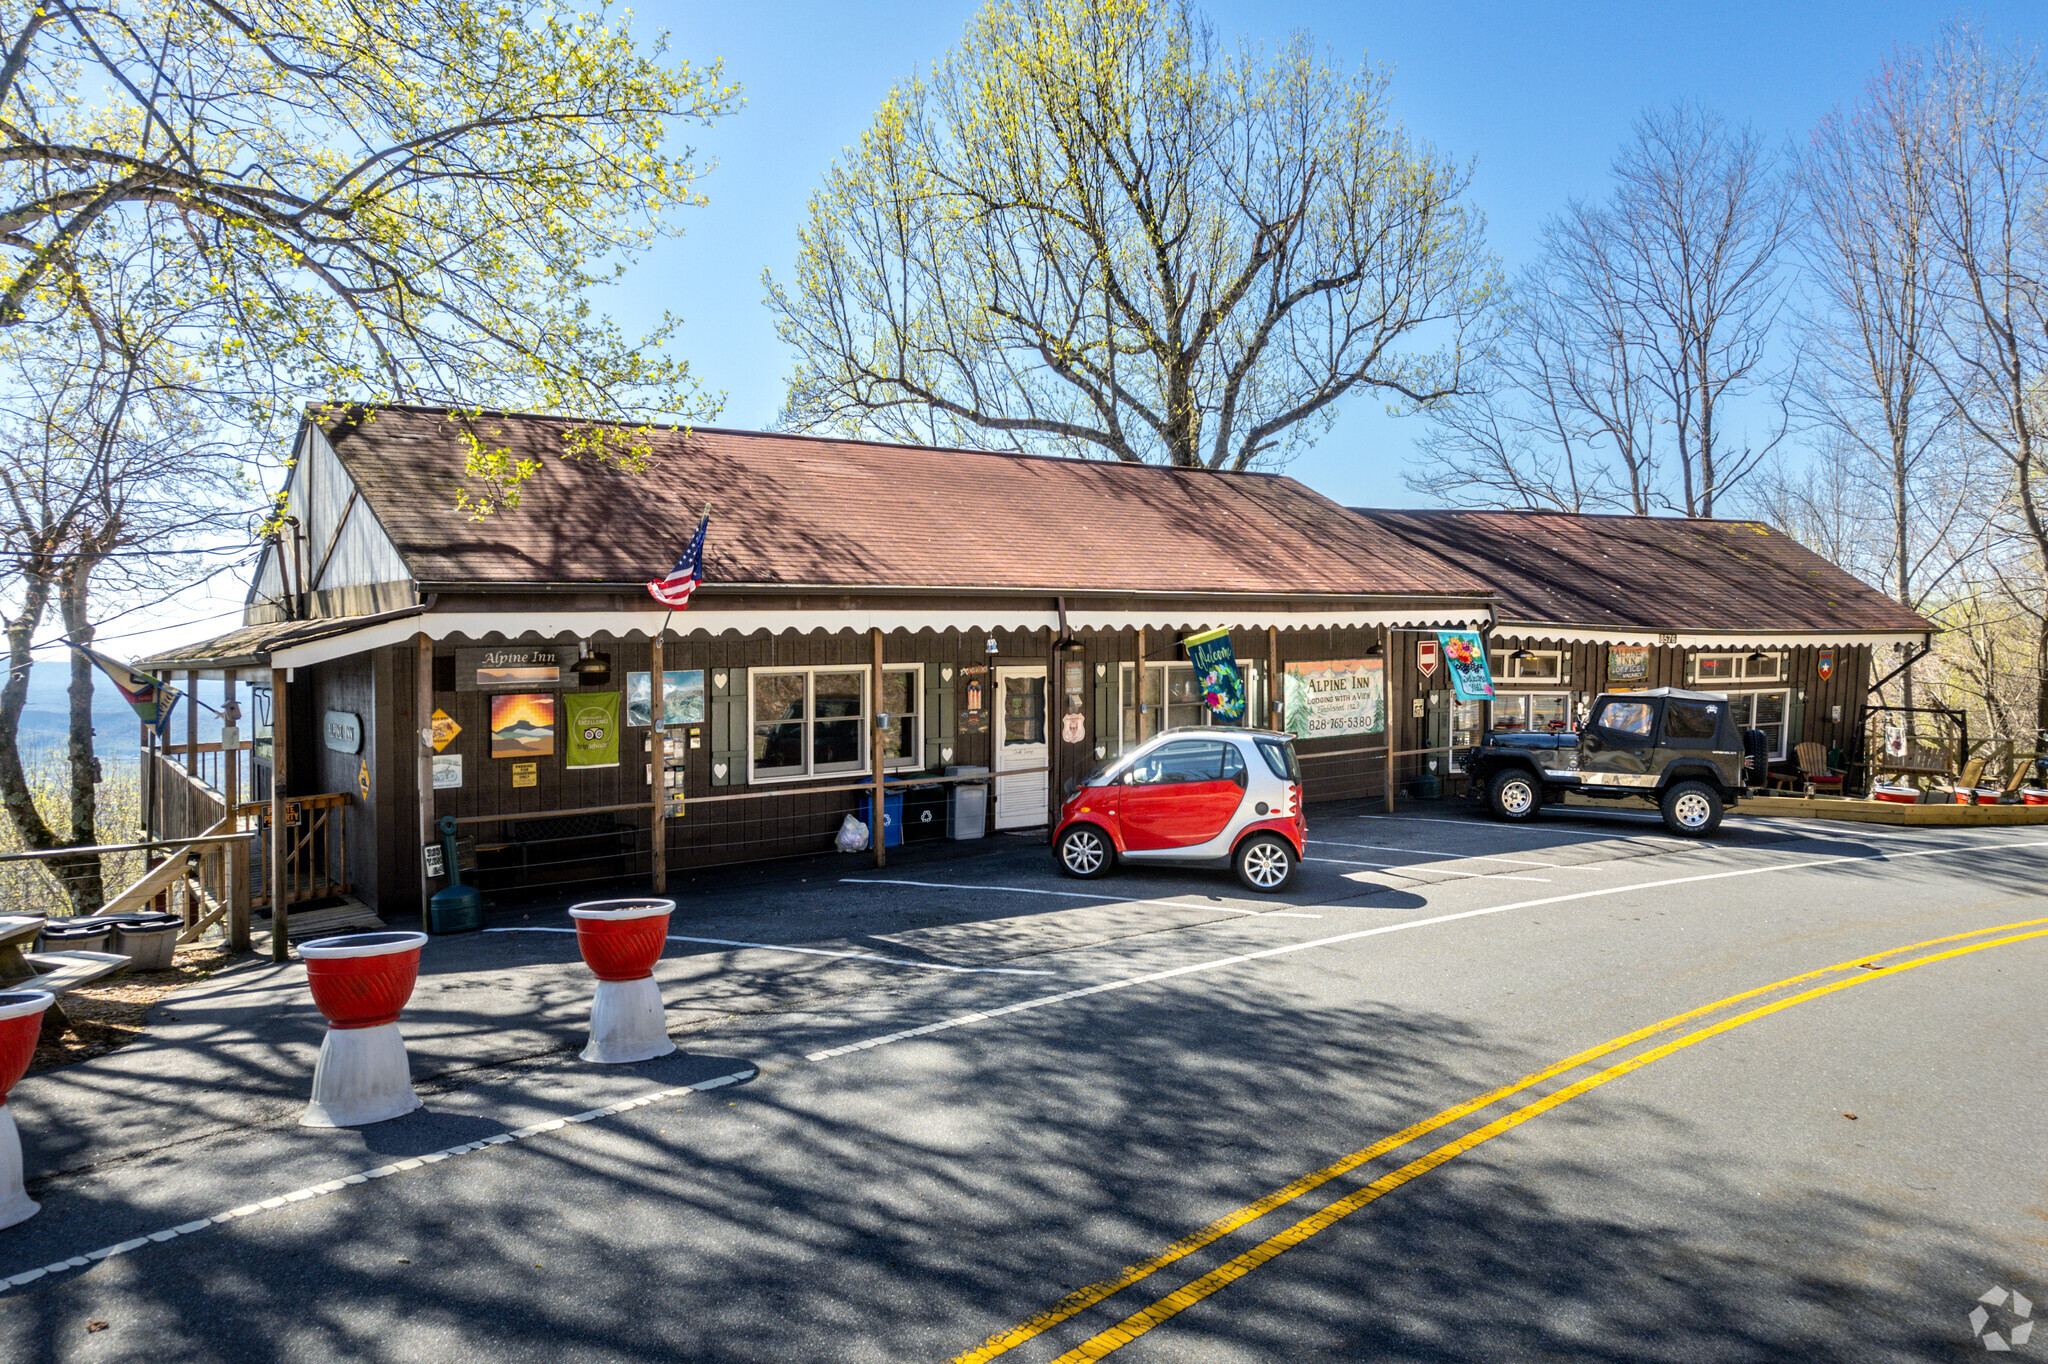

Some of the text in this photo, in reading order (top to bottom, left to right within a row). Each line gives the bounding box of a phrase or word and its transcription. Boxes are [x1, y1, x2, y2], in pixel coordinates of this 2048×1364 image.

[1660, 635, 1676, 643] 8576
[482, 651, 556, 667] Alpine Inn
[1195, 644, 1231, 671] Welcome
[1615, 648, 1642, 657] ALPINE
[1620, 657, 1636, 665] INN
[1616, 664, 1640, 672] OFFICE
[1307, 676, 1370, 693] ALPINE INN
[1307, 696, 1333, 705] LODGING
[1335, 694, 1351, 702] WITH
[1356, 692, 1371, 700] VIEW
[1309, 715, 1372, 731] 828-765-5380
